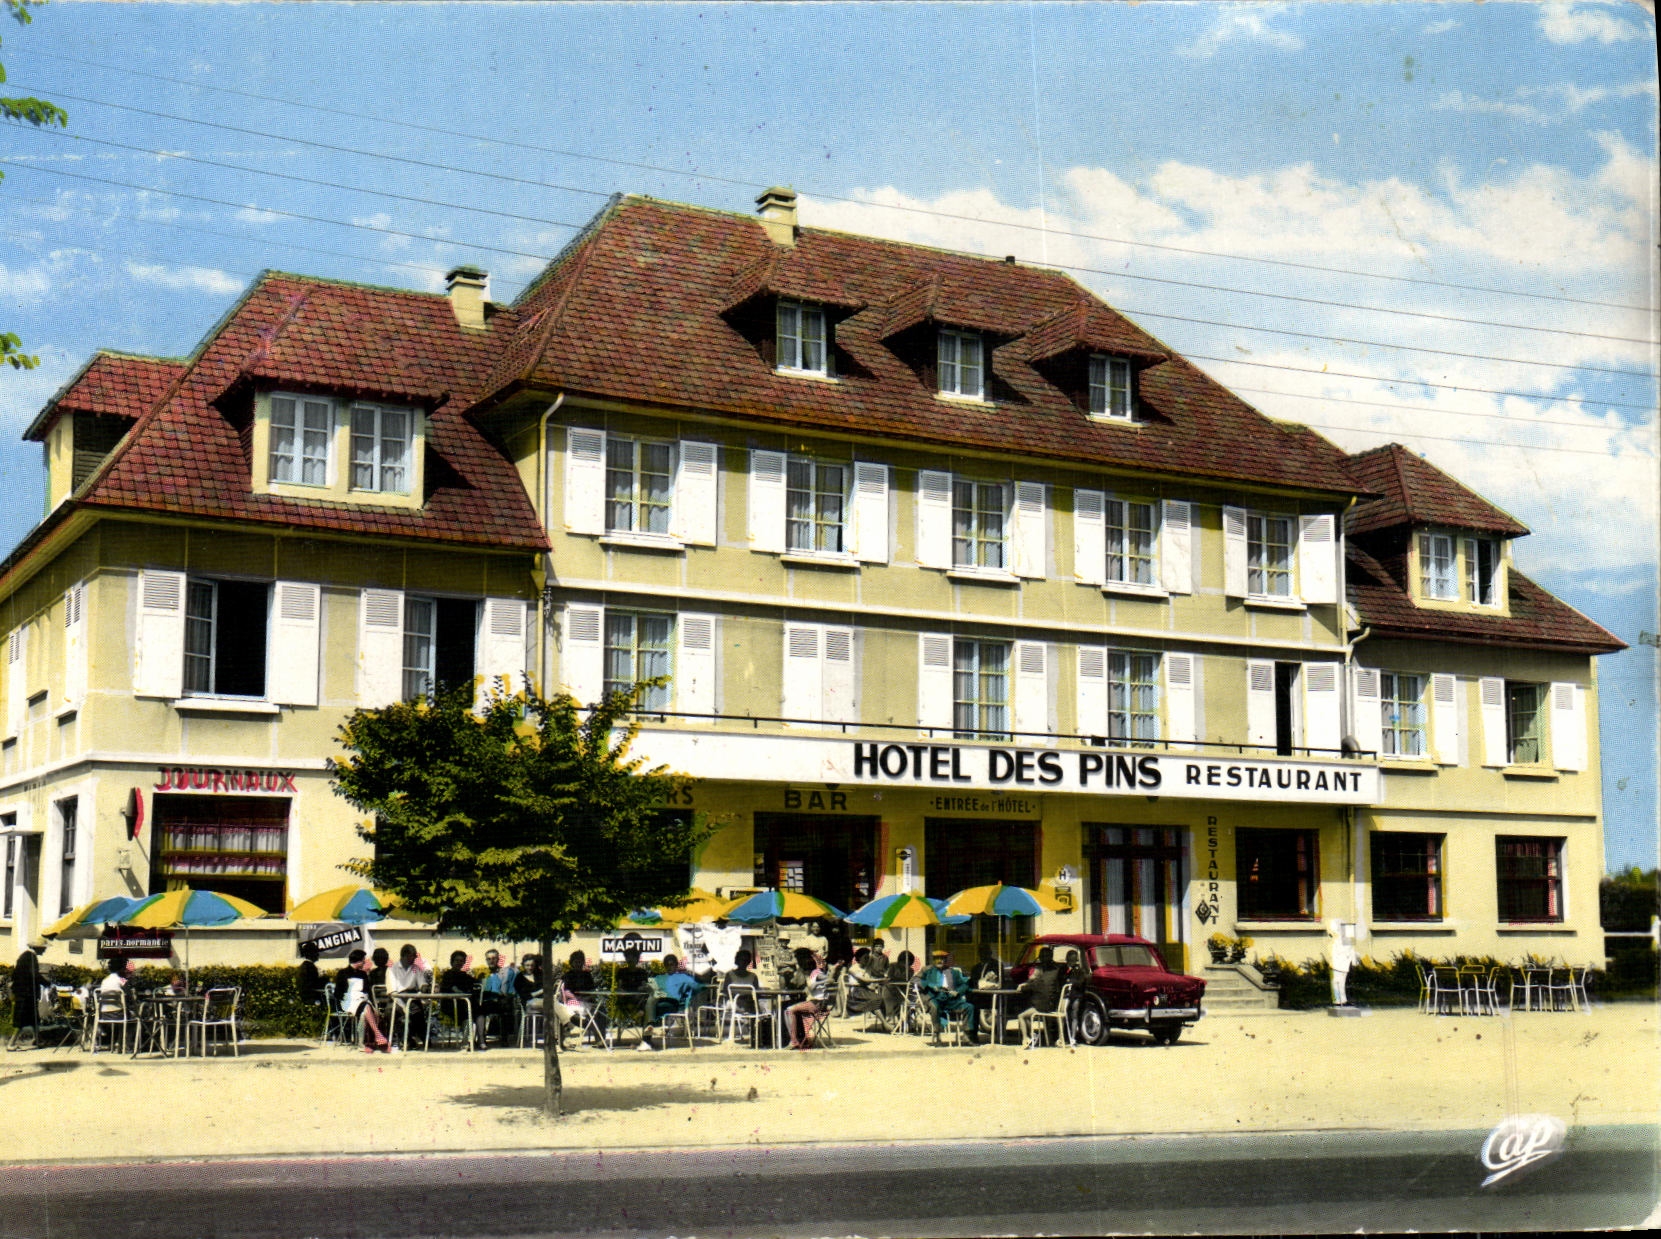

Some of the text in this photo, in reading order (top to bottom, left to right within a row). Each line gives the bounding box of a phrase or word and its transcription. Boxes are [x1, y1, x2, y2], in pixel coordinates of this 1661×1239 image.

[854, 742, 1162, 788] HOTEL DES PINS
[1186, 764, 1362, 792] RESTAURANT
[154, 766, 298, 792] JOURNAUX
[784, 788, 848, 811] BAR
[1206, 815, 1220, 925] RESTAURANT
[301, 928, 361, 951] ANGINA
[604, 939, 661, 952] MARTINI
